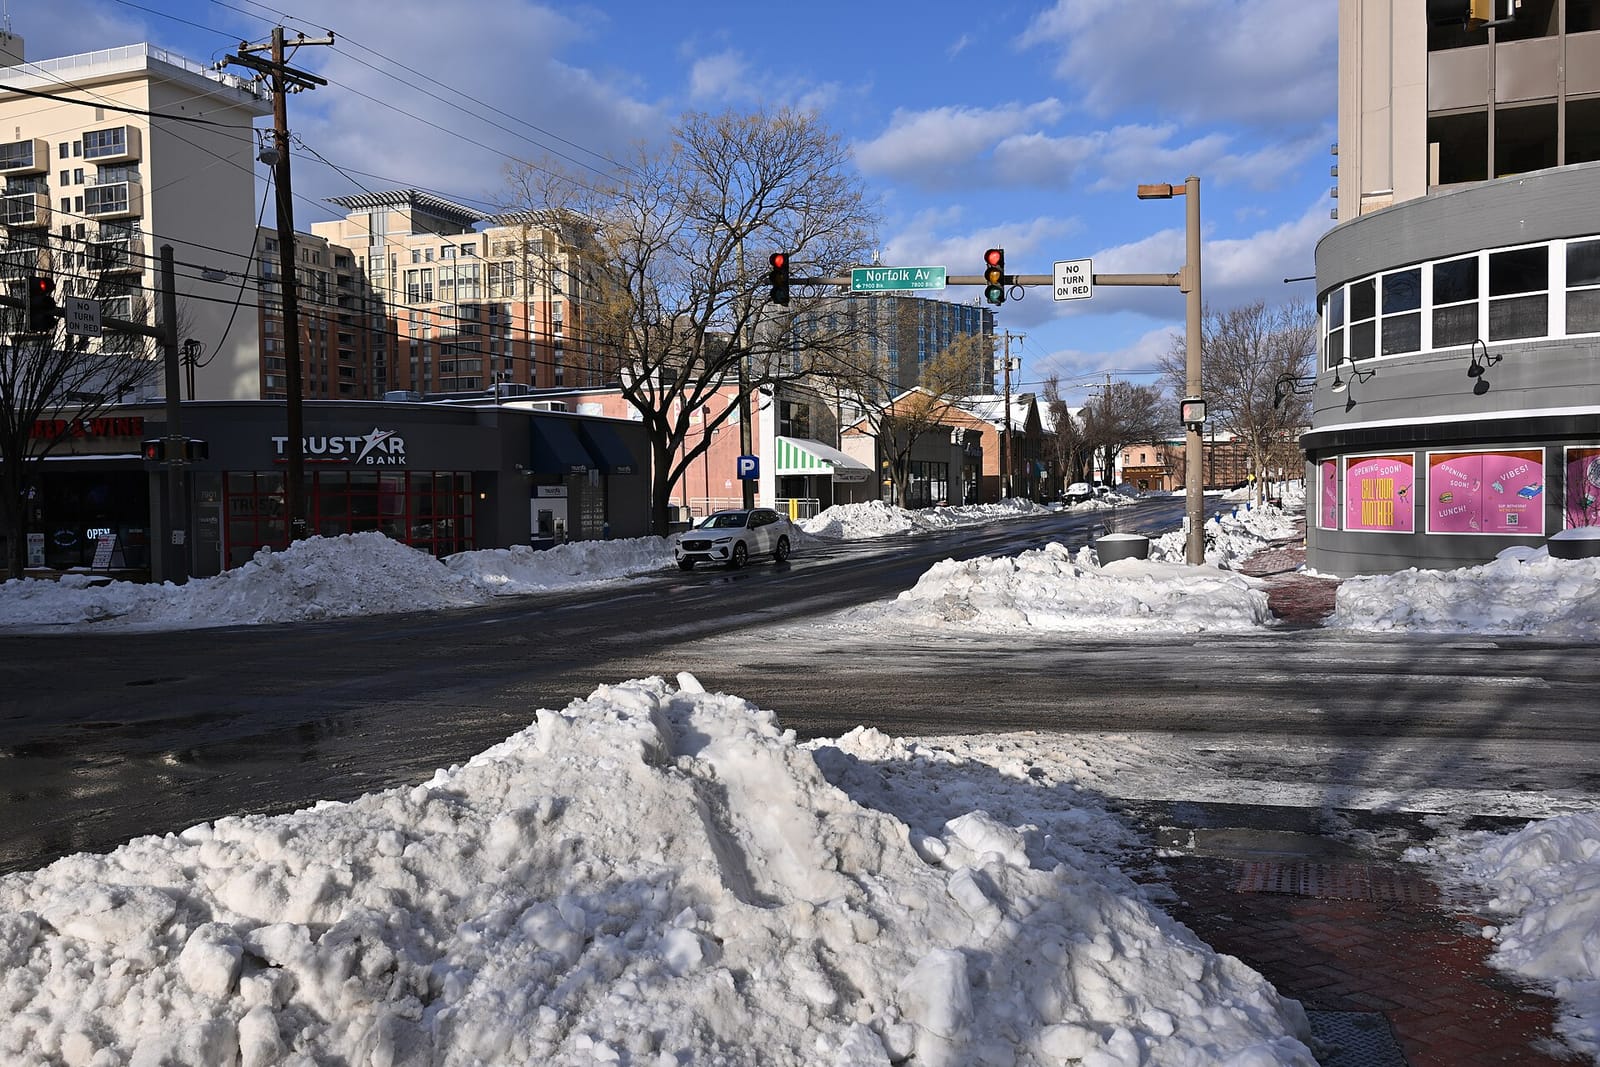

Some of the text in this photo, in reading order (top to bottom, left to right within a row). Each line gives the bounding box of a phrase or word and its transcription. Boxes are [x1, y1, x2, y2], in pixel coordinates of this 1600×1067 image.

[866, 268, 930, 281] Norfolk Av
[1066, 265, 1079, 274] NO
[1062, 275, 1084, 284] TURN
[1057, 285, 1089, 296] ON RED
[77, 302, 90, 310] NO
[73, 311, 94, 321] TURN
[69, 321, 99, 332] ON RED
[88, 416, 144, 437] WINE
[366, 456, 406, 465] BANK
[740, 459, 755, 476] P
[1354, 463, 1402, 477] OPENING SOON!
[1441, 464, 1468, 480] OPENING
[1500, 464, 1529, 481] VIBES!
[1375, 478, 1394, 499] YOUR
[1450, 479, 1469, 488] SOON!
[1361, 500, 1394, 526] MOTHER
[1438, 505, 1466, 517] LUNCH!
